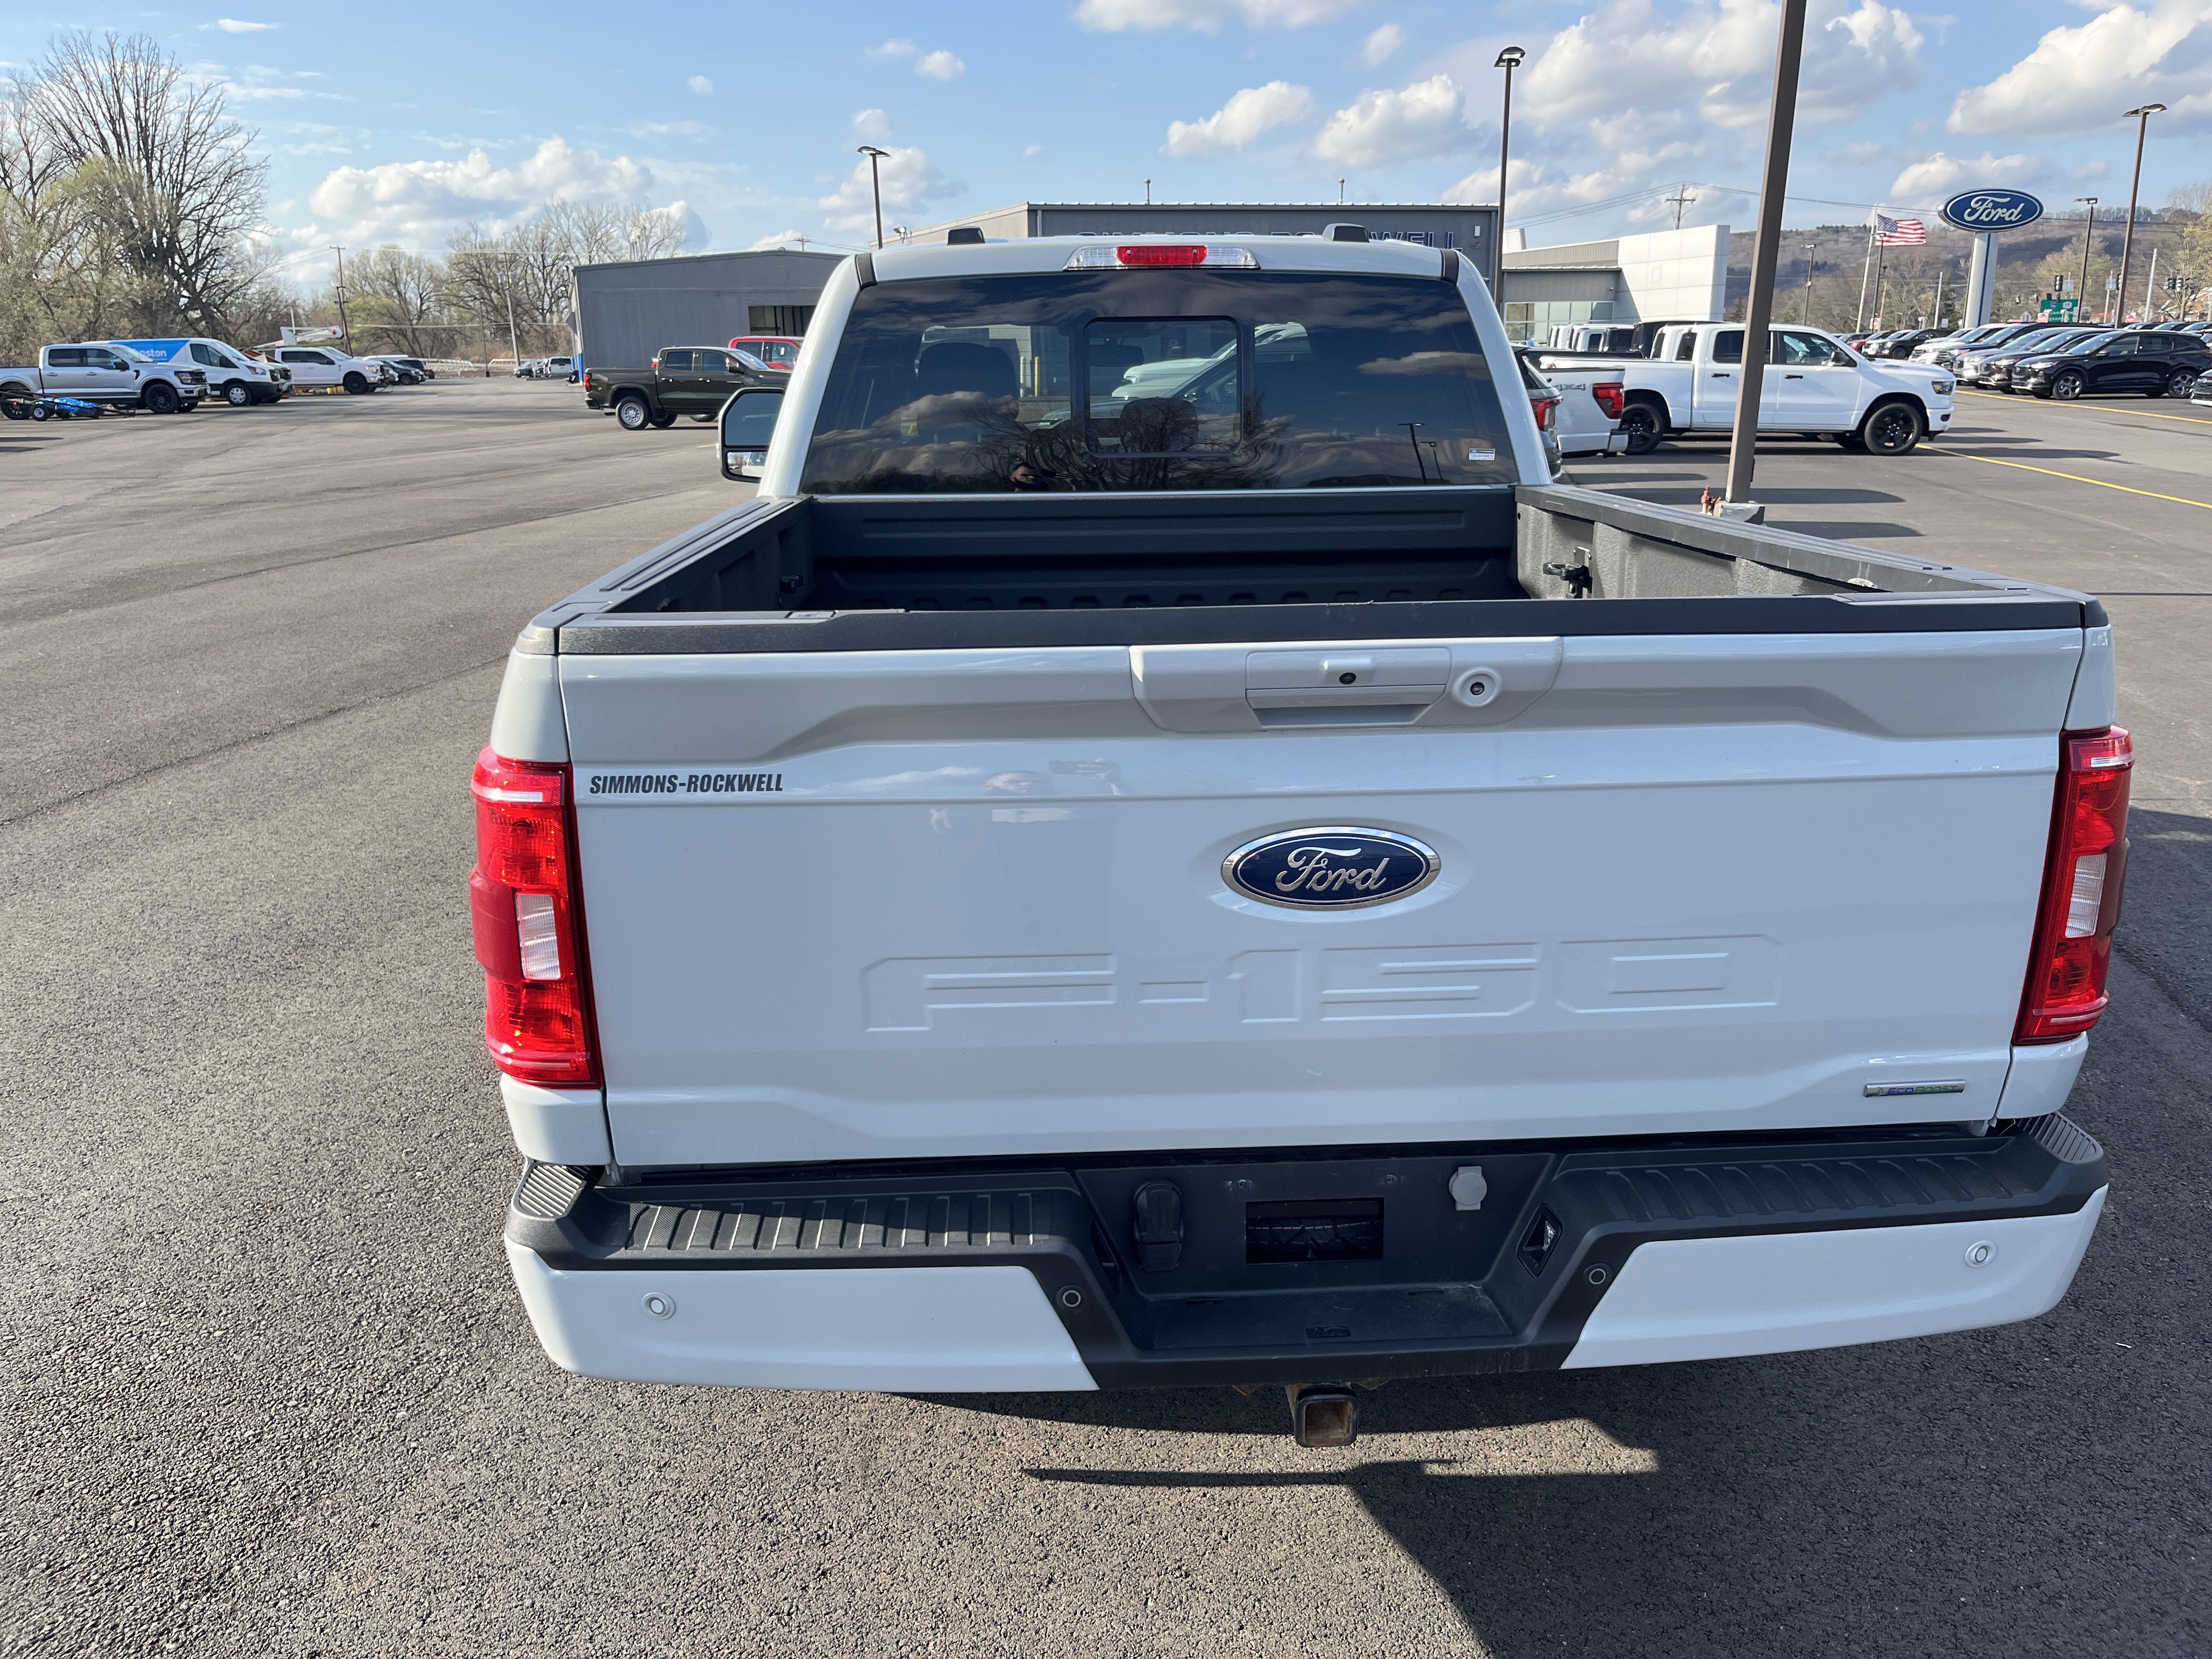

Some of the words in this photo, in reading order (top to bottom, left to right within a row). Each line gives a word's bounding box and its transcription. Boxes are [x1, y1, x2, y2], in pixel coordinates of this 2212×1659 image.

[1963, 195, 2025, 222] Ford
[590, 774, 783, 794] SIMMONS-ROCKWELL
[1275, 847, 1391, 892] Ford
[860, 934, 1784, 1031] F-150
